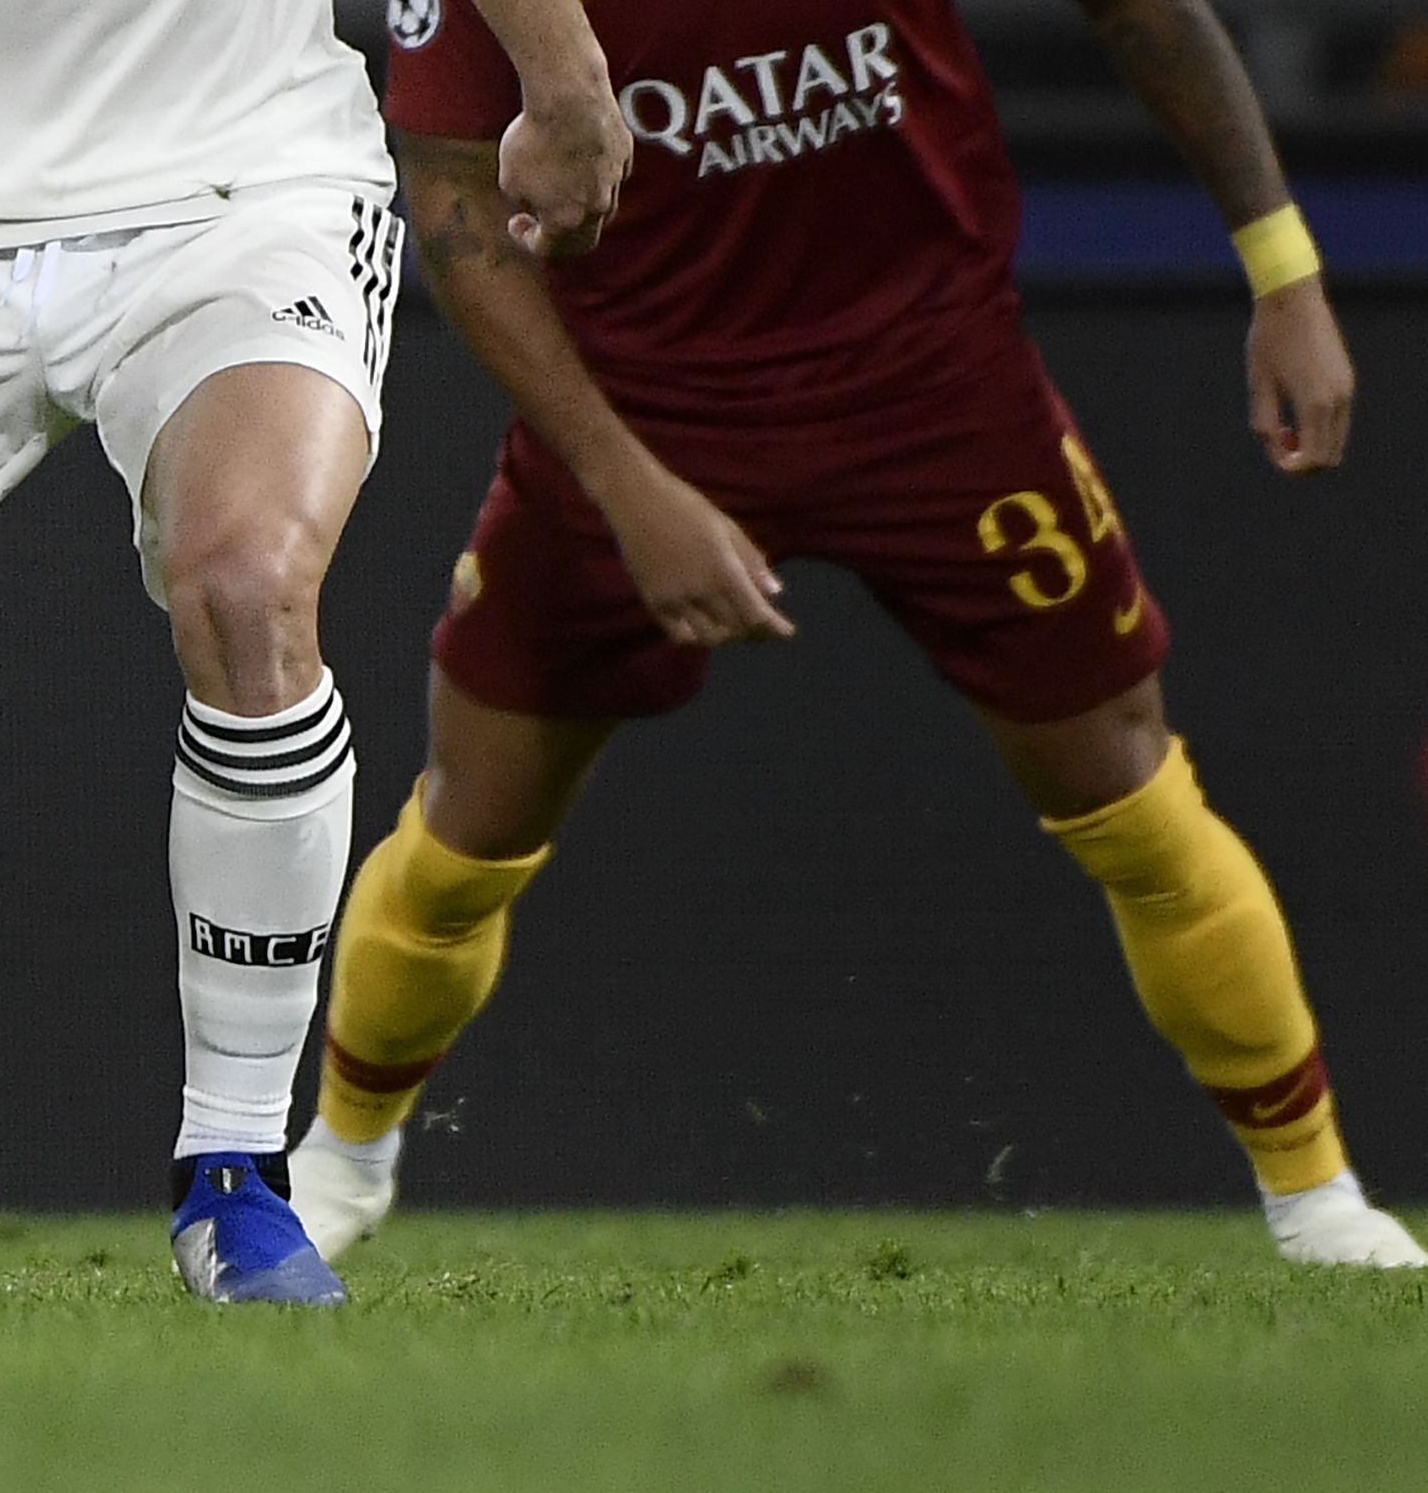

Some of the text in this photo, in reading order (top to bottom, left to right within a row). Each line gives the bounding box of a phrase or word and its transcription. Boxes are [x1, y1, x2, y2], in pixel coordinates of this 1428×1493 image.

[619, 22, 898, 154] QATAR
[698, 81, 902, 178] AIRWAYS
[977, 432, 1122, 607] 34
